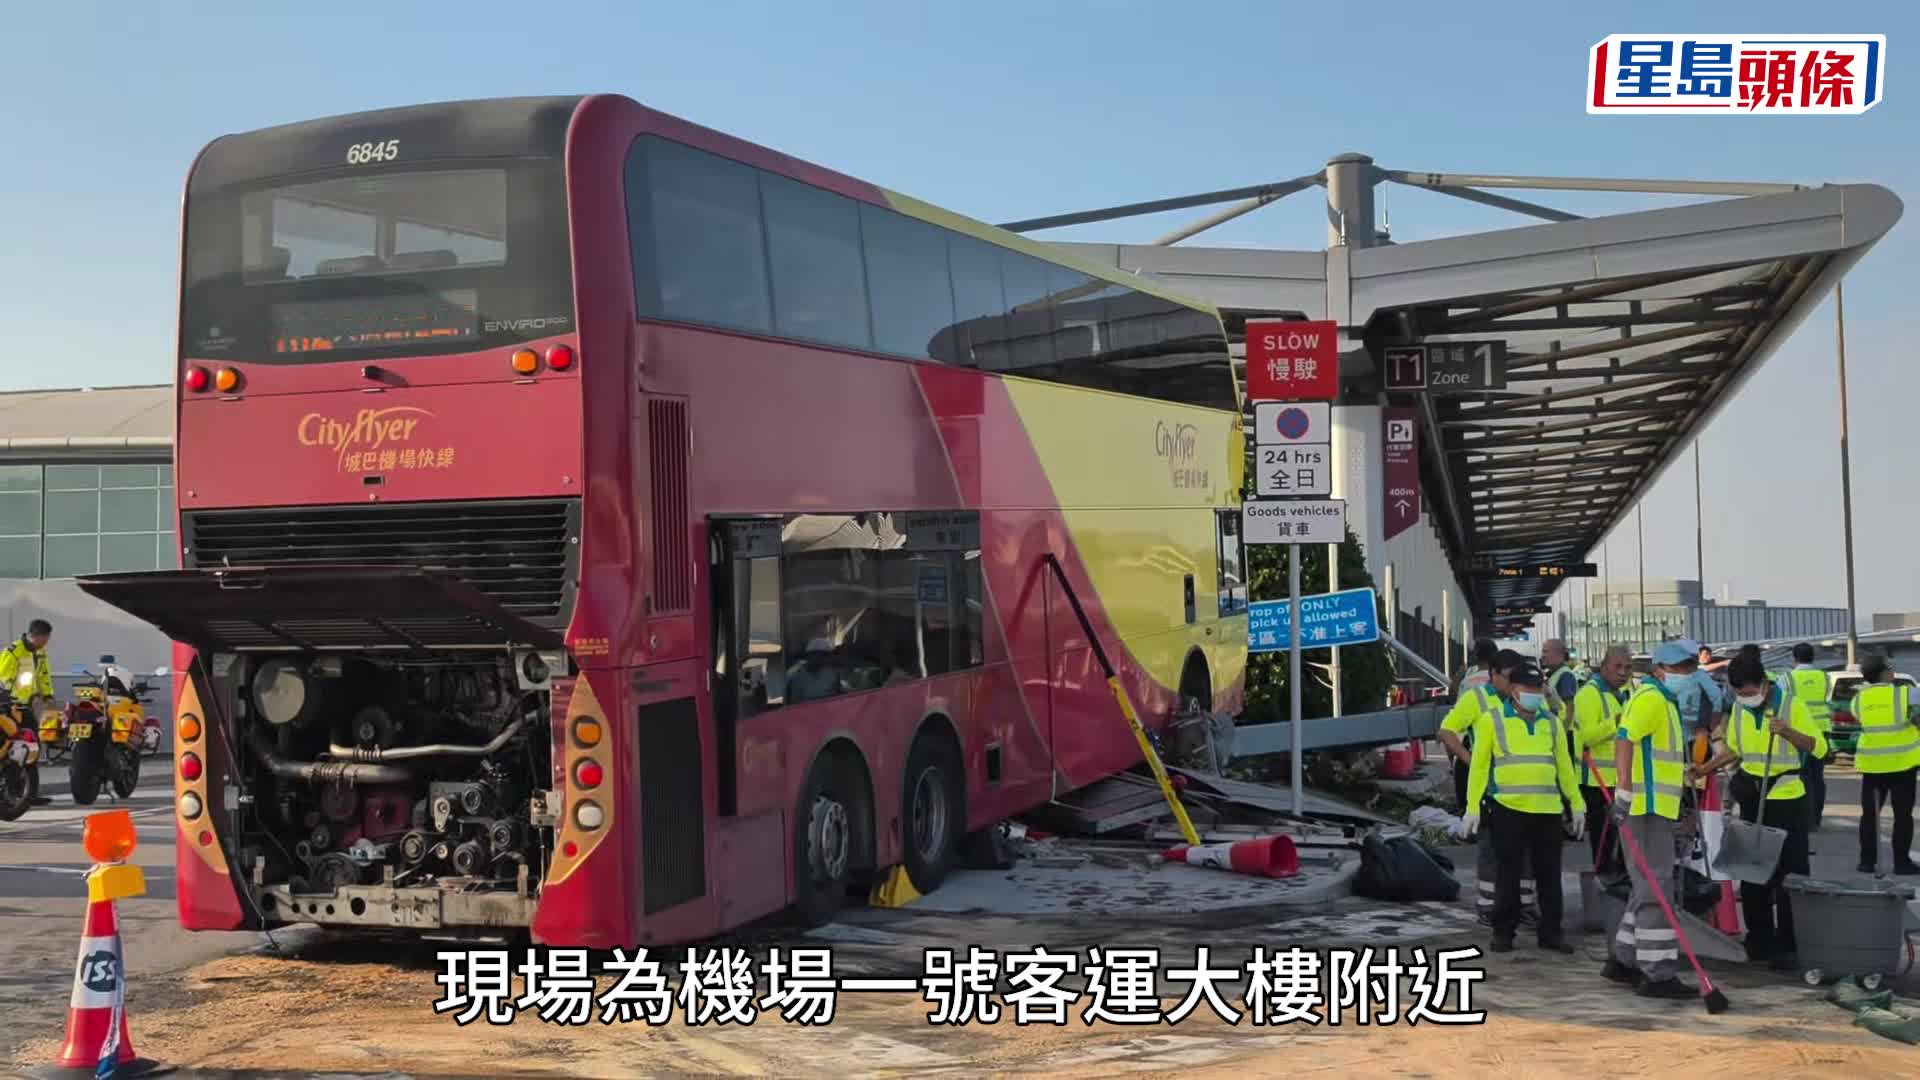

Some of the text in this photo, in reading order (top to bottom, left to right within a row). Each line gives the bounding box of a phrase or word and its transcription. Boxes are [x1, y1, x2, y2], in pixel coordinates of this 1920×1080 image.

[347, 139, 400, 164] 6845
[1263, 334, 1319, 350] SLOW
[1267, 358, 1317, 381] 慢駛
[1388, 354, 1420, 381] T1
[1431, 344, 1492, 387] Zone 1
[345, 448, 455, 472] 城巴機場快線
[1264, 450, 1321, 464] 24 hrs
[1270, 468, 1314, 490] 全日
[1247, 505, 1340, 517] Goods vehicles
[1278, 522, 1311, 536] 貨車
[1248, 608, 1273, 617] rop
[1301, 598, 1340, 611] ONLY
[1251, 619, 1278, 629] pick
[1303, 608, 1357, 623] allowed
